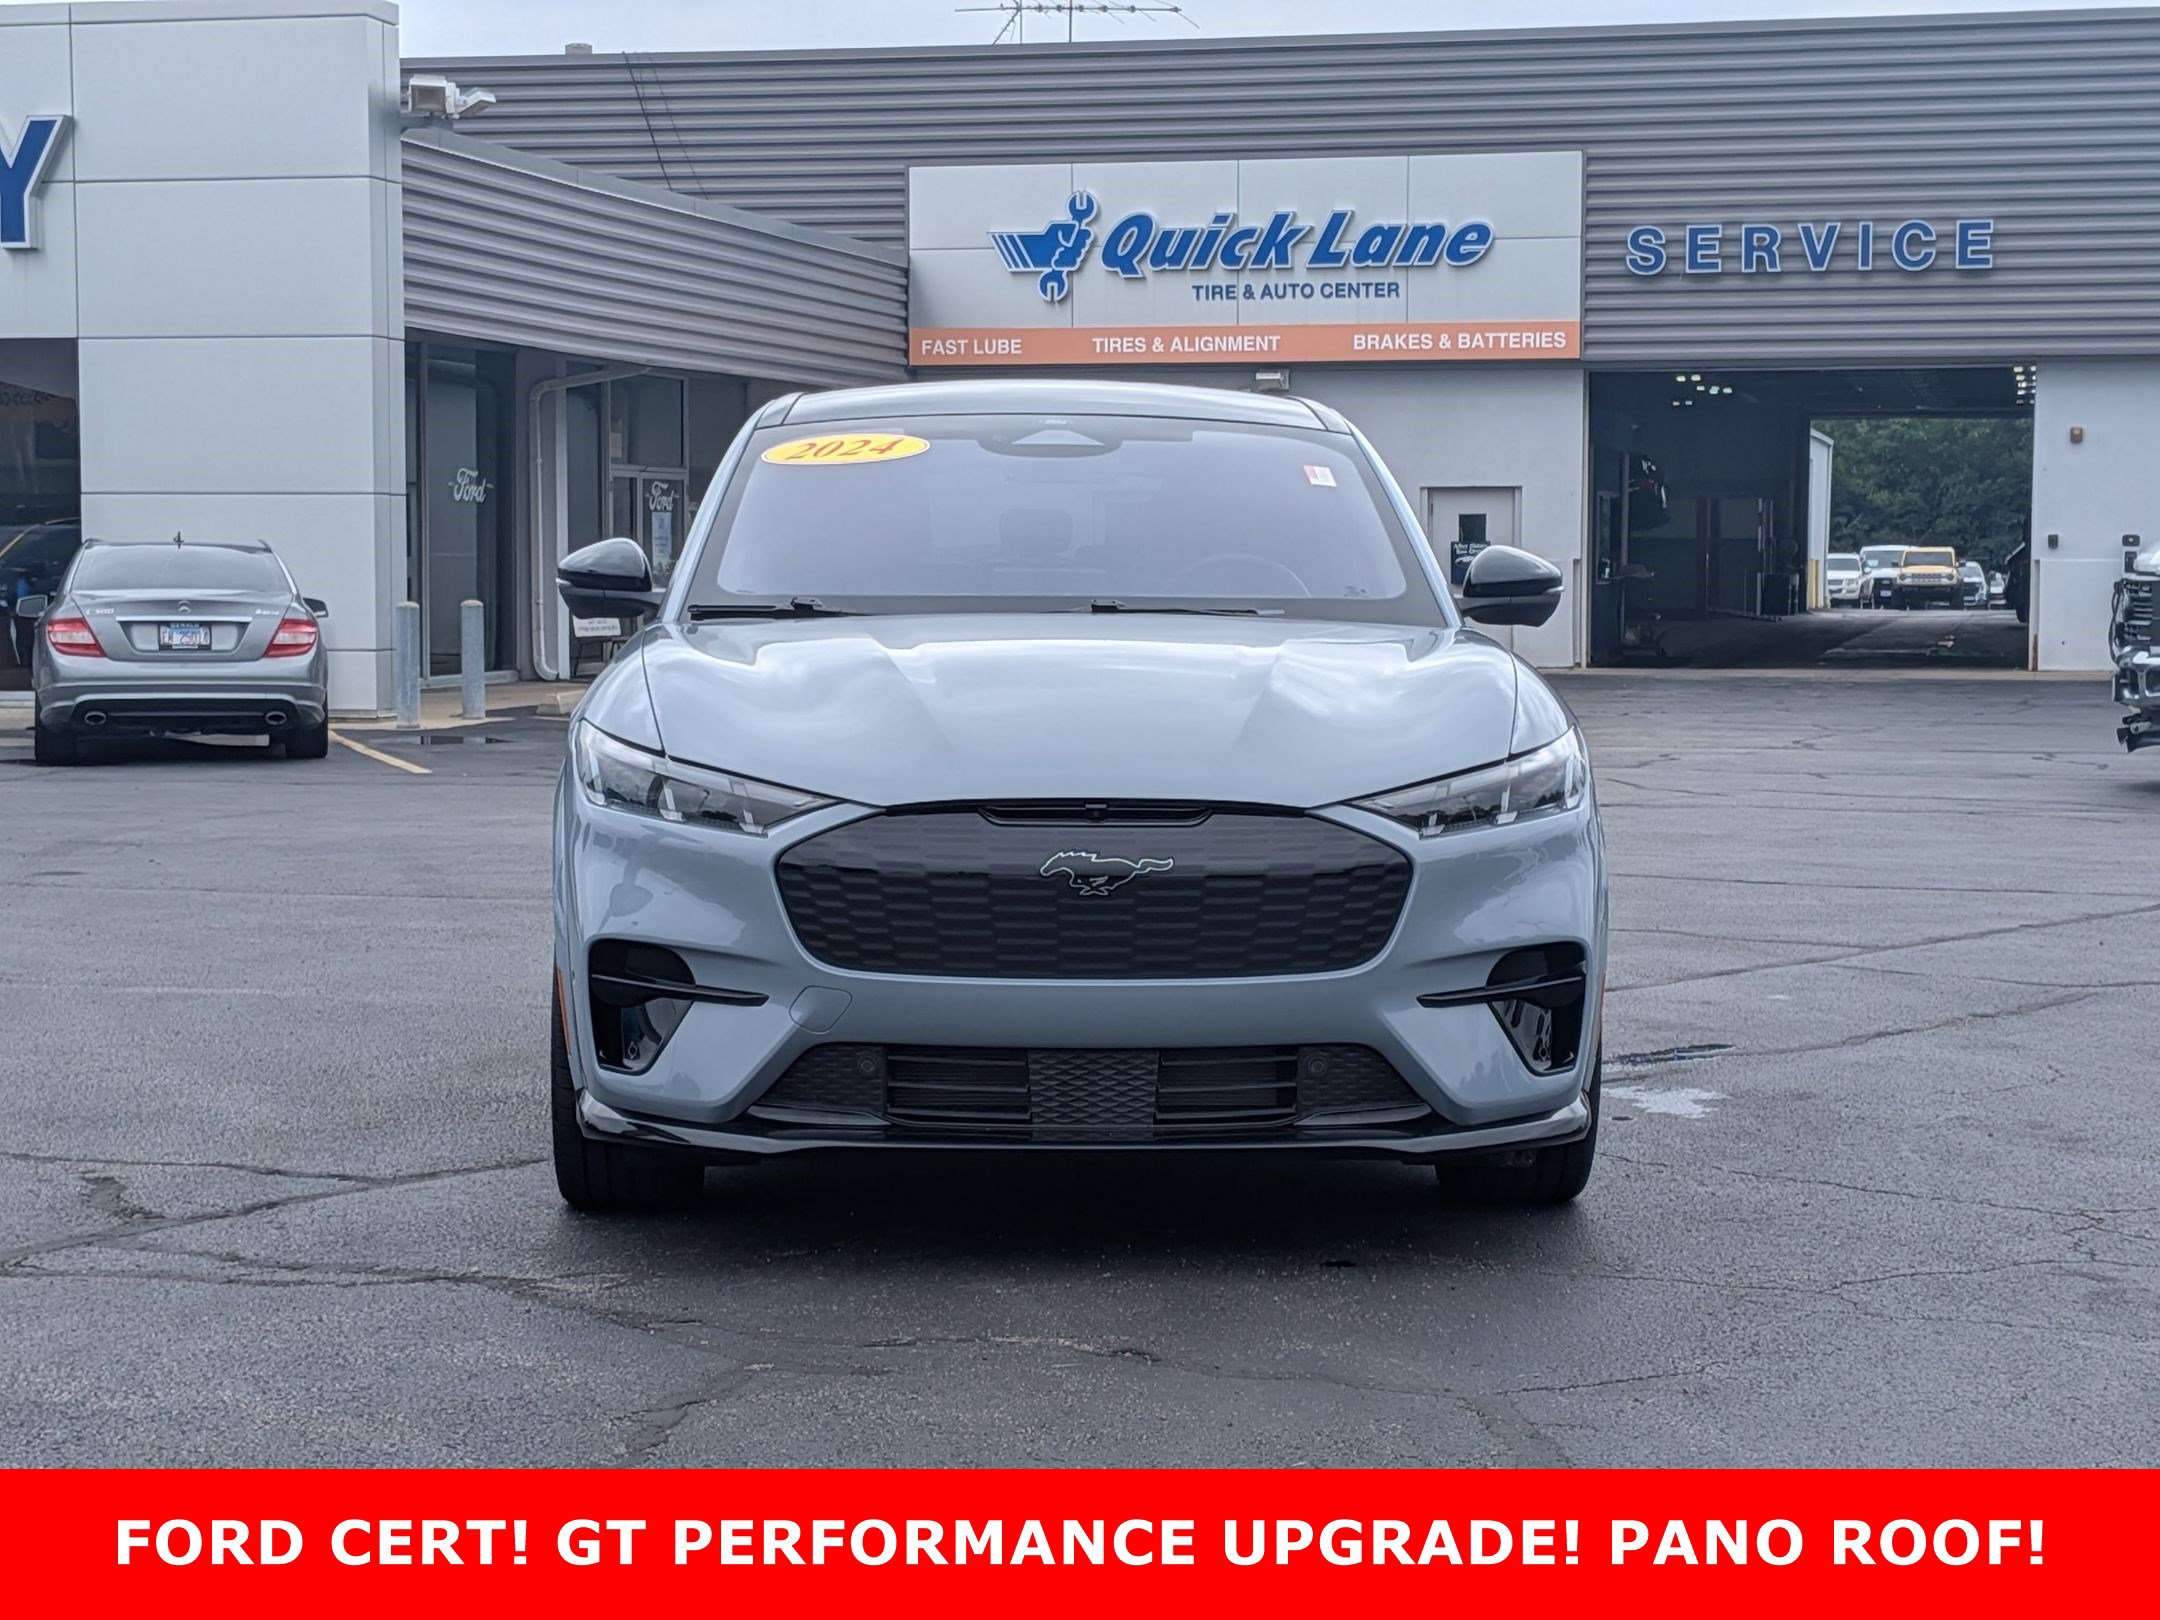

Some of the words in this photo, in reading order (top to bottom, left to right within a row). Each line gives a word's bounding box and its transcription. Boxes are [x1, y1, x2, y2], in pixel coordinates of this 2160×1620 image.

[1099, 210, 1313, 279] Quick
[1305, 209, 1496, 268] Lane
[1626, 218, 1995, 276] SERVICE
[1192, 285, 1237, 301] TIRE
[1242, 285, 1255, 300] &
[1260, 283, 1316, 300] AUTO
[1320, 282, 1400, 299] CENTER
[921, 339, 968, 355] FAST
[973, 339, 1022, 355] LUBE
[1092, 337, 1146, 353] TIRES
[1152, 336, 1164, 353] &
[1170, 335, 1281, 352] ALIGNMENT
[1353, 333, 1433, 350] BRAKES
[1439, 333, 1452, 349] &
[1458, 331, 1567, 349] BATTERIES
[784, 438, 904, 460] 2024
[453, 467, 487, 503] Ford
[649, 481, 674, 511] Ford
